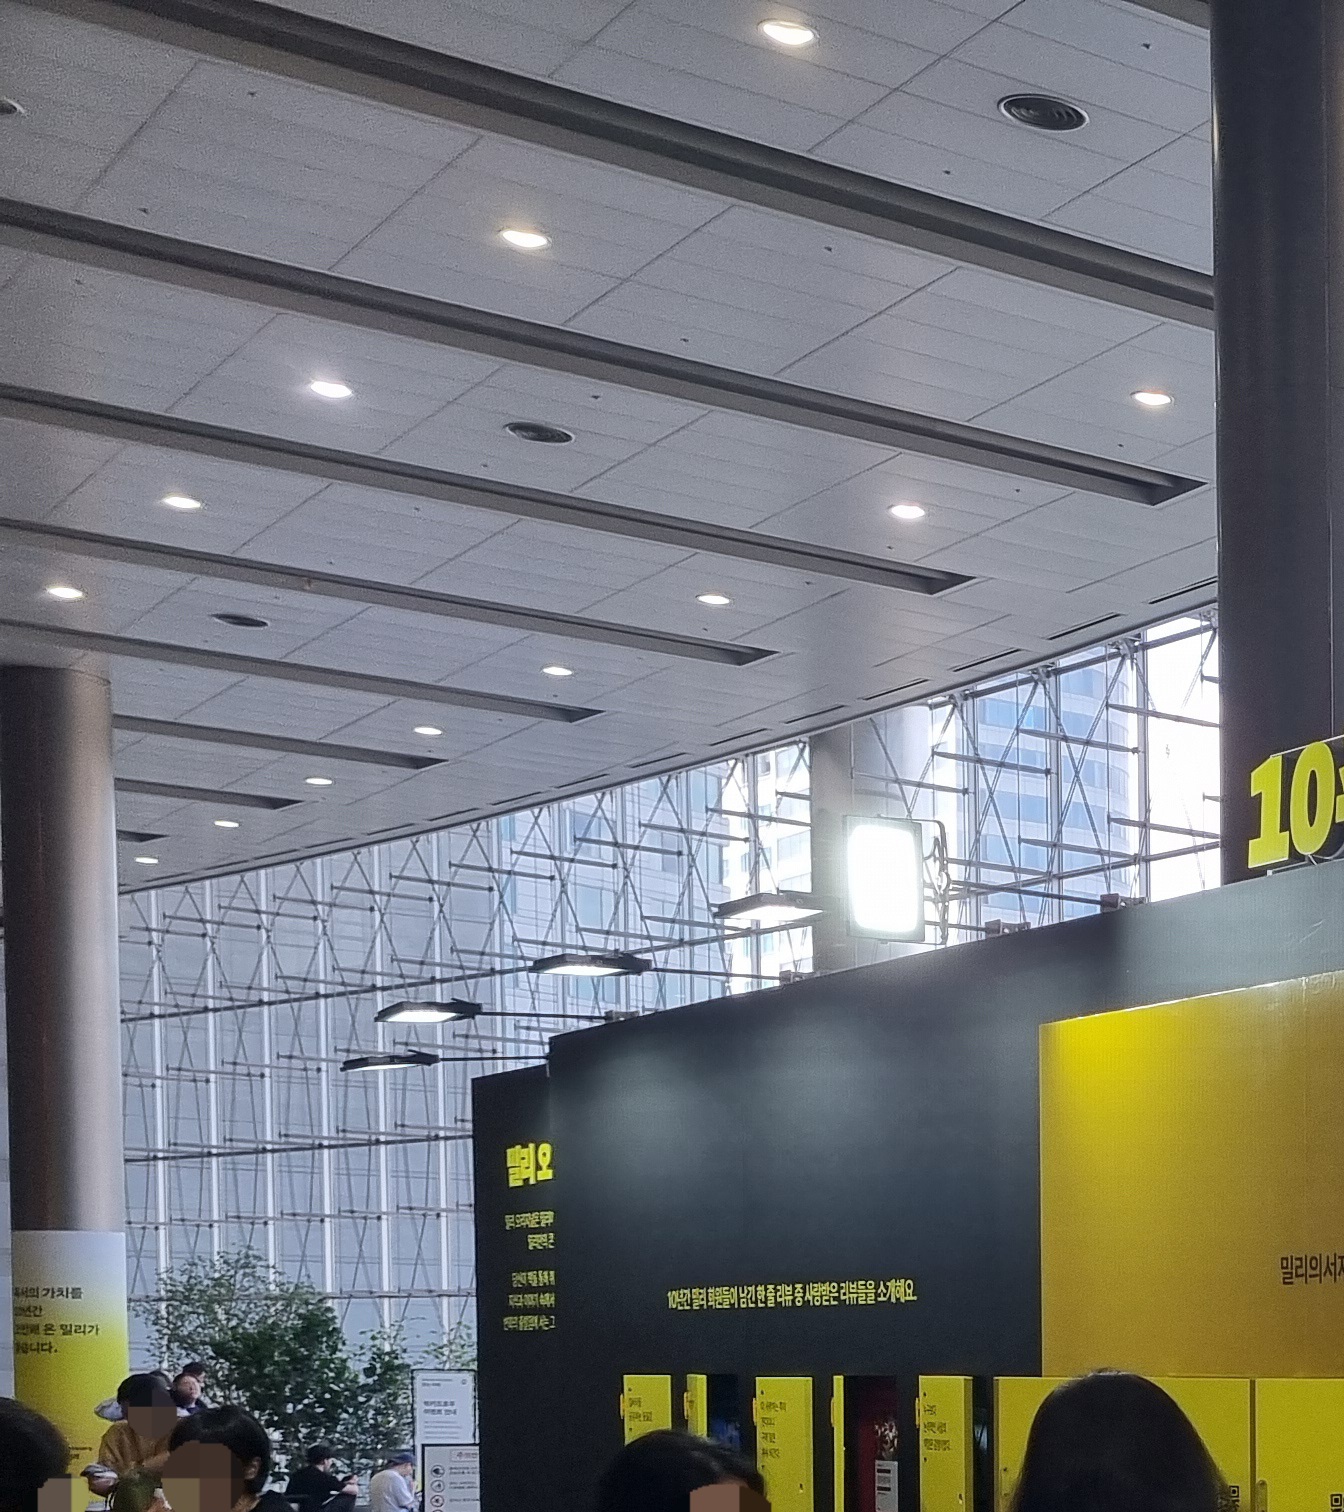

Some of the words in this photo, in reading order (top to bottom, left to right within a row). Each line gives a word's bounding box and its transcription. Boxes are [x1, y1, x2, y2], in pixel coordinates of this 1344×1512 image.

[667, 1287, 691, 1310] 10년간
[692, 1287, 707, 1309] 밀리
[708, 1286, 738, 1308] 회원들이
[739, 1285, 755, 1308] 남긴
[756, 1284, 765, 1307] 한
[766, 1284, 775, 1307] 줄
[776, 1283, 793, 1307] 리뷰
[794, 1283, 802, 1306] 중
[804, 1281, 839, 1306] 사랑받은
[840, 1280, 875, 1305] 리뷰들을
[877, 1279, 918, 1303] 소개해요.
[59, 1323, 100, 1337] 밀리가
